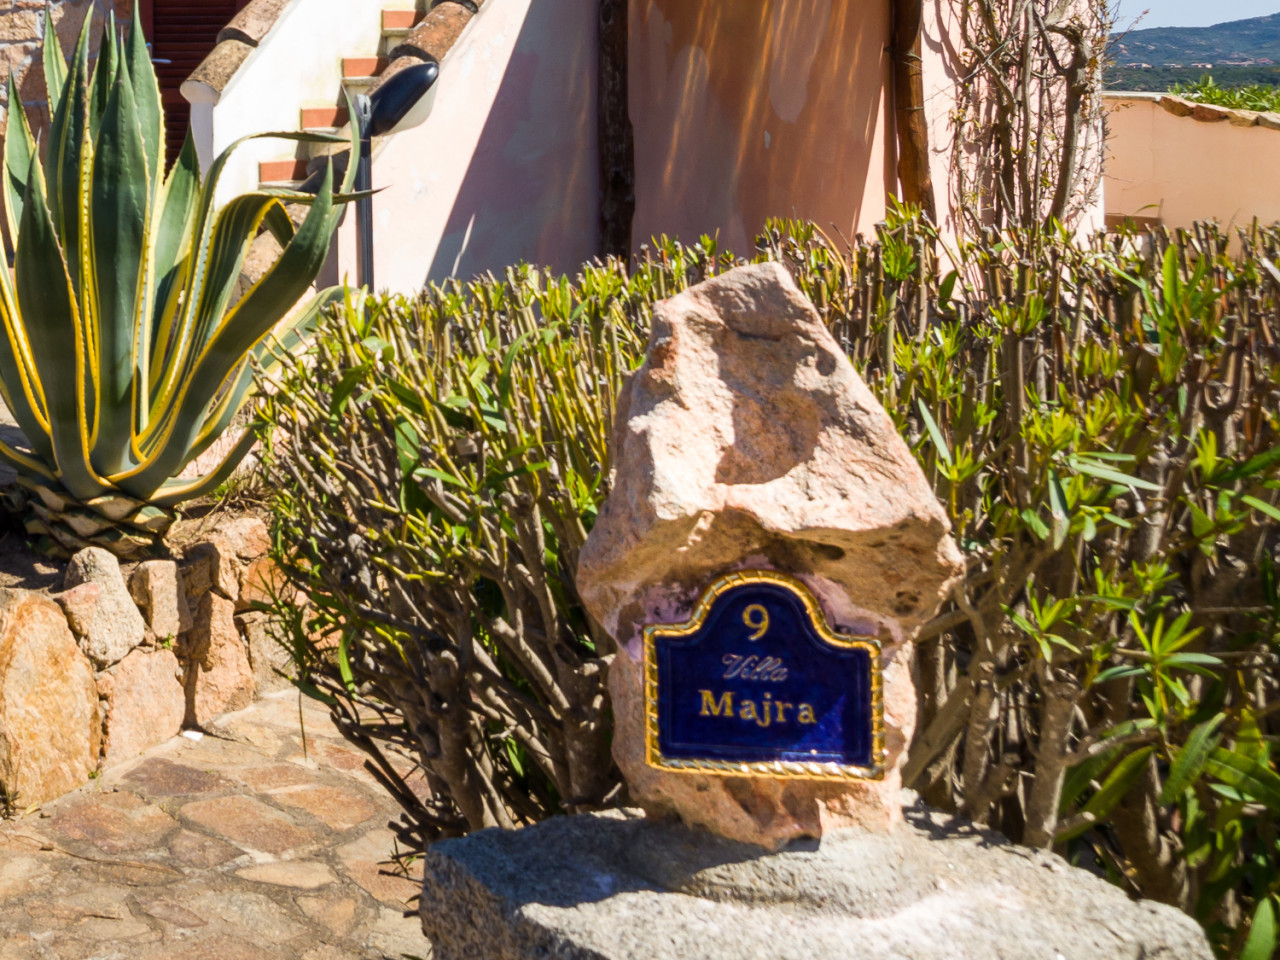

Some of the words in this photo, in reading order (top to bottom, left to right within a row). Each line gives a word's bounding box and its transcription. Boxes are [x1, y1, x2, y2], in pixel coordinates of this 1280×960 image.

[742, 604, 770, 641] 9
[722, 653, 789, 681] Villa
[698, 689, 817, 727] Majra
